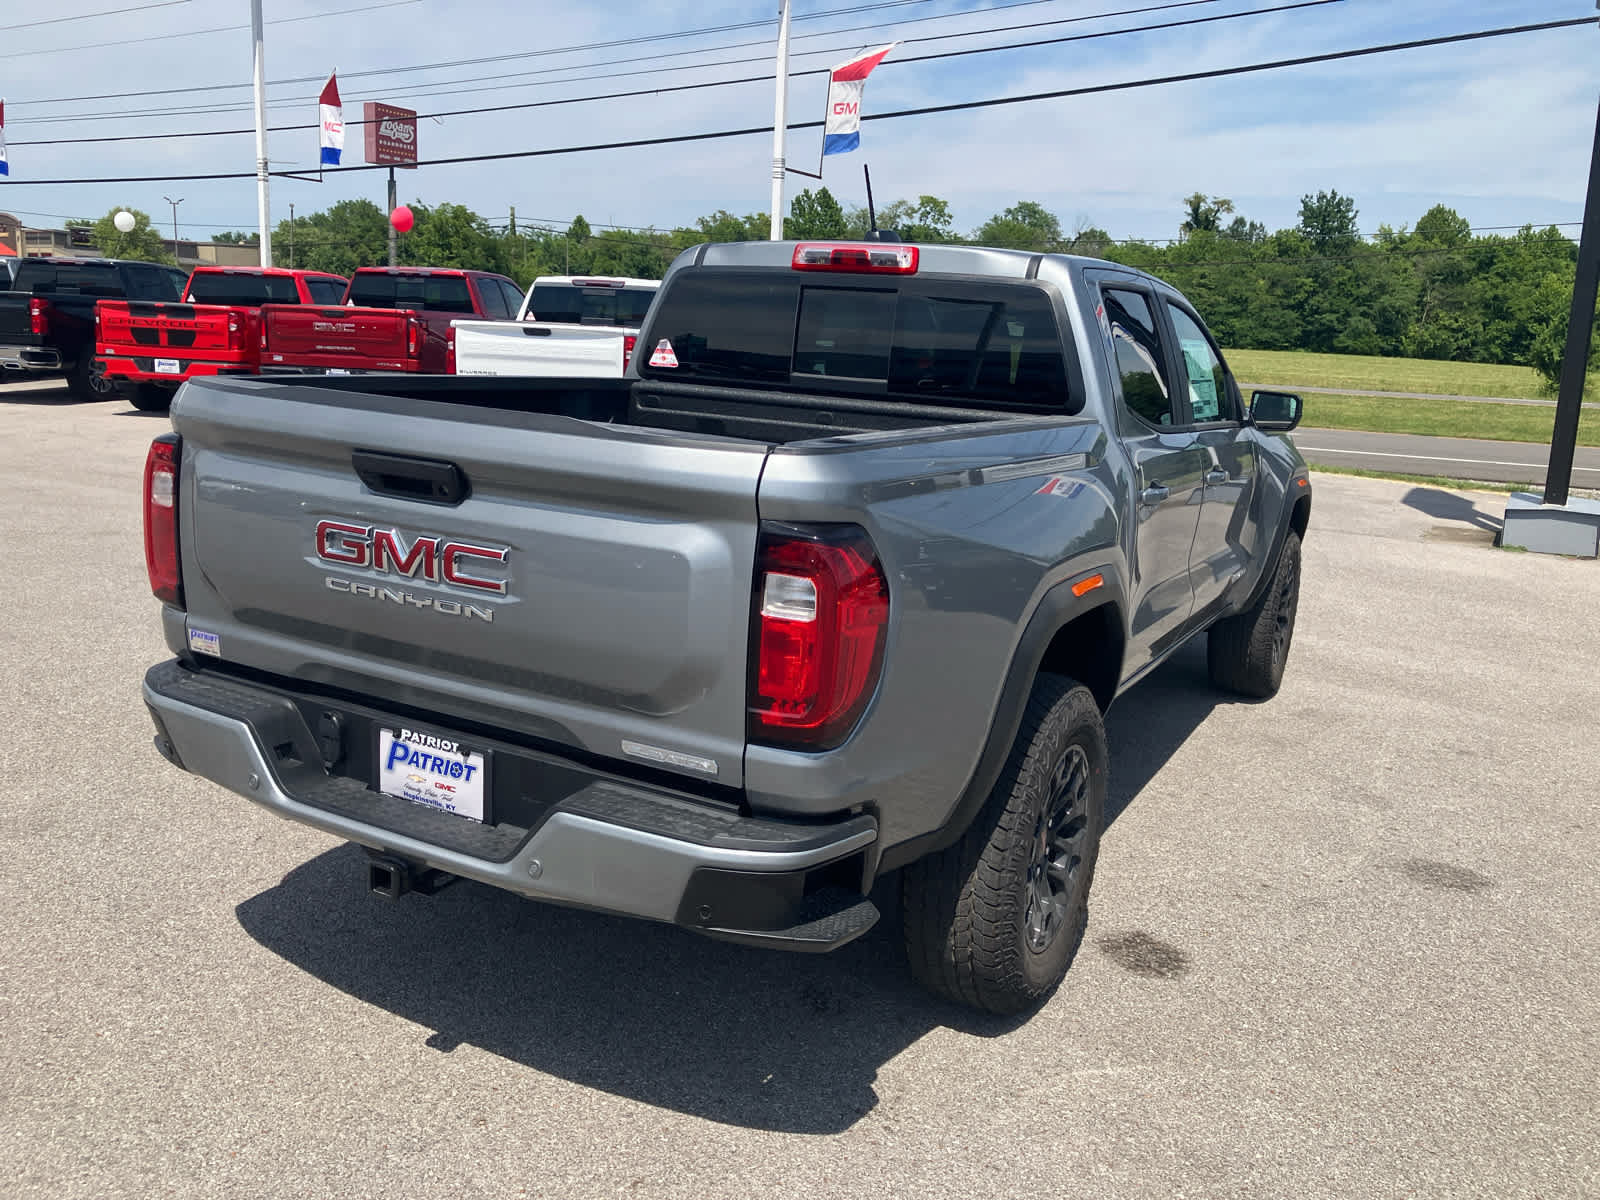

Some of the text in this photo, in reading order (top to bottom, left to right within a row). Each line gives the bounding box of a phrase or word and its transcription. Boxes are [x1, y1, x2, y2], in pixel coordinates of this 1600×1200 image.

[107, 317, 218, 330] CHEVROLET
[316, 520, 510, 595] GMC
[325, 576, 494, 623] CANYON
[401, 729, 459, 752] PATRIOT
[387, 741, 476, 781] PATRIOT
[434, 782, 456, 793] GMC
